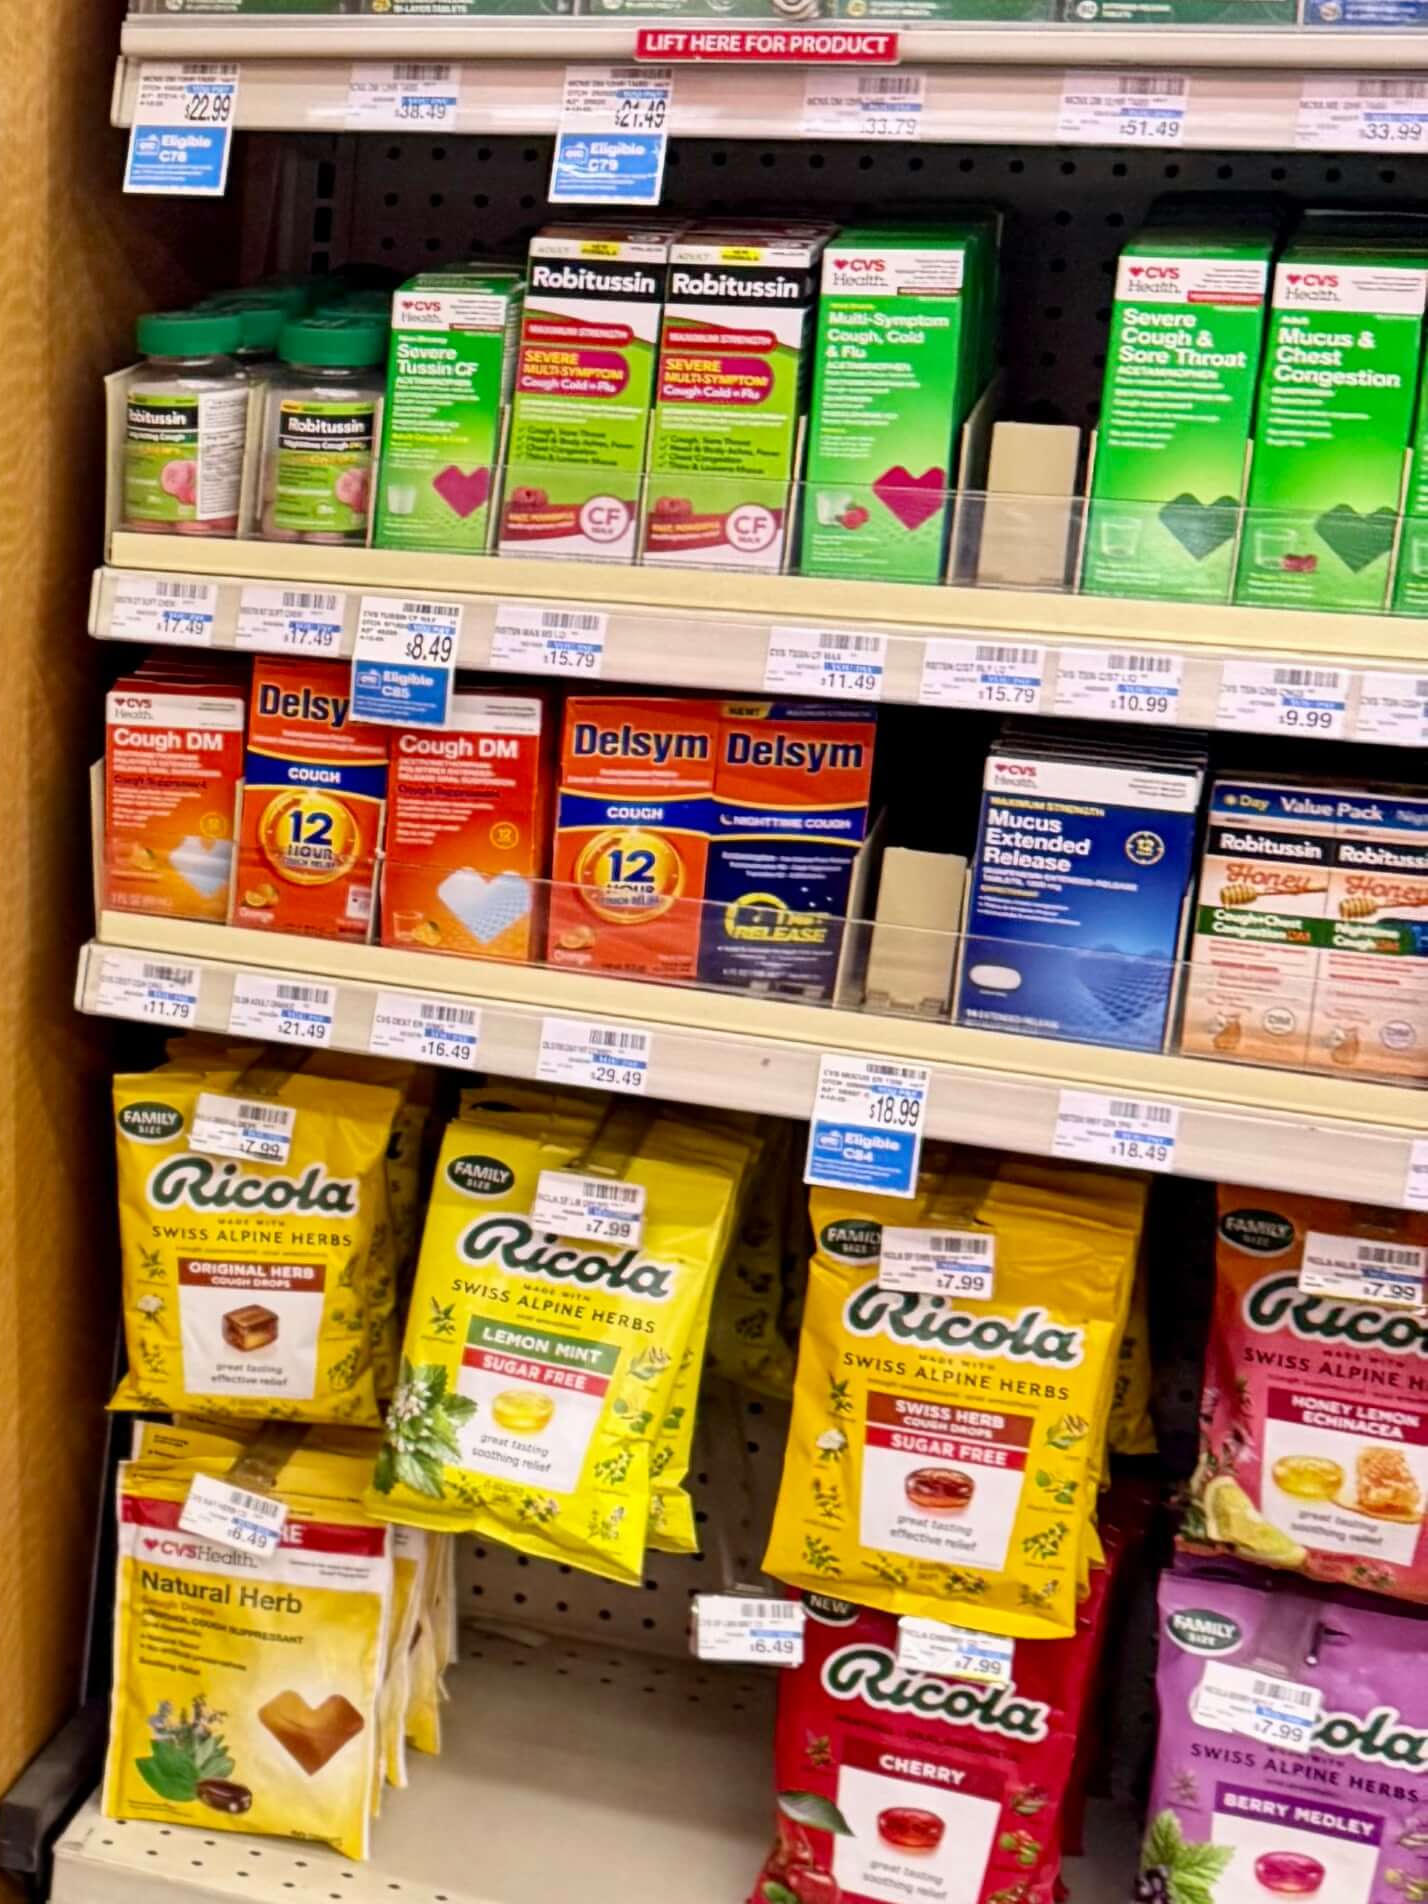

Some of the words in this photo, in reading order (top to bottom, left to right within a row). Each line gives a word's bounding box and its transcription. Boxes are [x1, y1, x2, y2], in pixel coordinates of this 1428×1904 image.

[646, 32, 686, 52] LIFT
[691, 32, 741, 52] HERE
[747, 33, 787, 52] FOR
[792, 33, 889, 54] PRODUCT
[184, 96, 230, 122] $22.99
[532, 266, 655, 294] Robitussin
[828, 311, 949, 330] Multi-Symptom
[1124, 309, 1196, 329] Severe
[1121, 328, 1190, 349] Cough
[1196, 331, 1212, 348] &
[1279, 328, 1353, 348] Mucus
[1358, 331, 1375, 348] &
[398, 344, 457, 361] Severe
[1119, 346, 1169, 366] Sore
[1175, 349, 1245, 368] Throat
[1277, 346, 1341, 366] Chest
[397, 360, 451, 376] Tussin
[455, 361, 478, 377] CF
[1275, 366, 1400, 388] Congestion
[405, 634, 452, 663] $8.49
[1279, 710, 1332, 729] $9.99
[114, 729, 182, 751] Cough
[187, 732, 223, 751] DM
[574, 723, 709, 762] Delsym
[989, 809, 1062, 833] Mucus
[1281, 797, 1332, 818] Value
[1337, 801, 1382, 822] Pack
[289, 809, 333, 846] 12
[986, 829, 1090, 856] Extended
[984, 847, 1071, 874] Release
[1226, 862, 1310, 890] Honey
[122, 1109, 178, 1128] FAMILY
[870, 1098, 919, 1127] $18.99
[152, 1158, 356, 1212] Ricola
[152, 1225, 211, 1241] SWISS
[217, 1228, 286, 1245] ALPINE
[292, 1232, 352, 1248] HERBS
[189, 1260, 263, 1277] ORIGINAL
[269, 1264, 315, 1280] HERB
[462, 1217, 671, 1298] Ricola
[845, 1282, 1082, 1364] Ricola
[483, 1326, 547, 1354] LEMON
[554, 1340, 602, 1365] MINT
[483, 1353, 541, 1379] SUGAR
[545, 1365, 586, 1389] FREE
[142, 1569, 231, 1604] Natural
[239, 1582, 302, 1616] Herb
[881, 1754, 964, 1785] CHERRY
[1225, 1791, 1288, 1820] BERRY
[1295, 1804, 1374, 1837] MEDLEY
